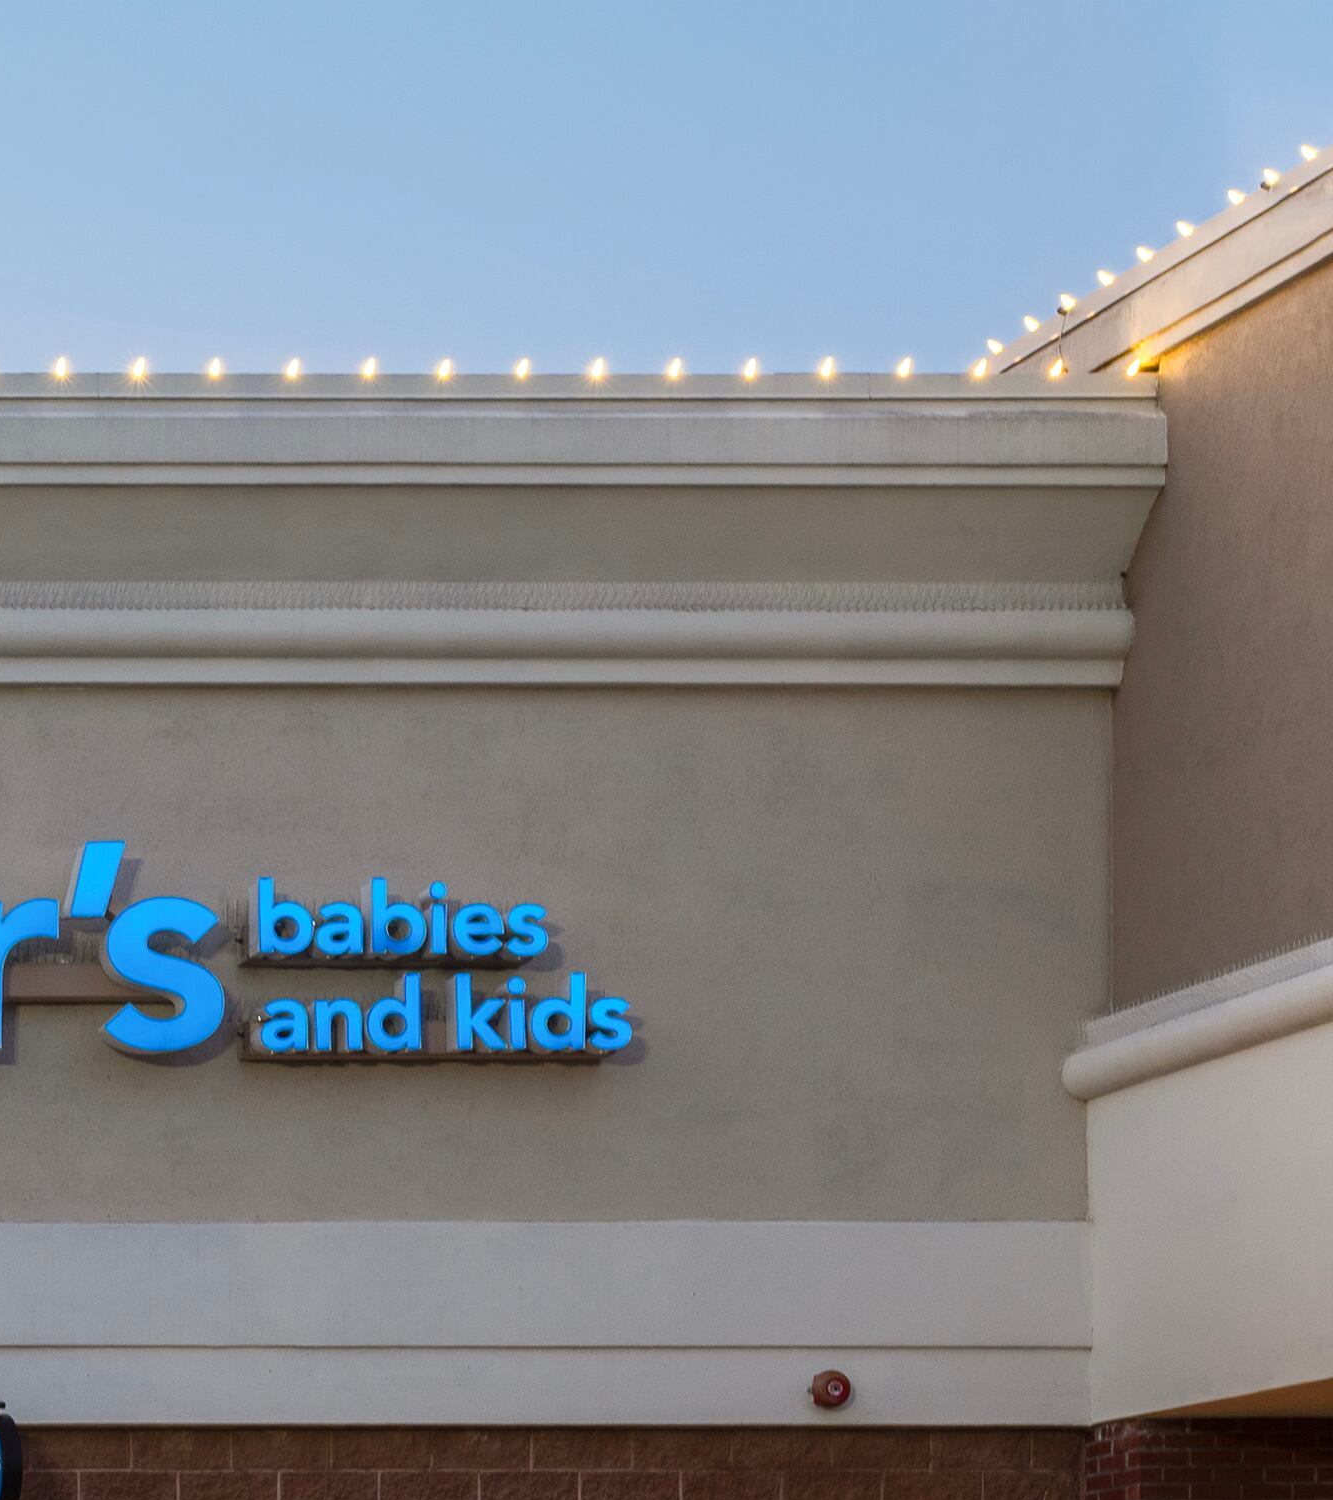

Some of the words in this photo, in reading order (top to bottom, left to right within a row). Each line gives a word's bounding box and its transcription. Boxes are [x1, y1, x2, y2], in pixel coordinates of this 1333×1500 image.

[257, 876, 549, 957] babies
[260, 972, 422, 1052] and
[454, 972, 633, 1052] kids
